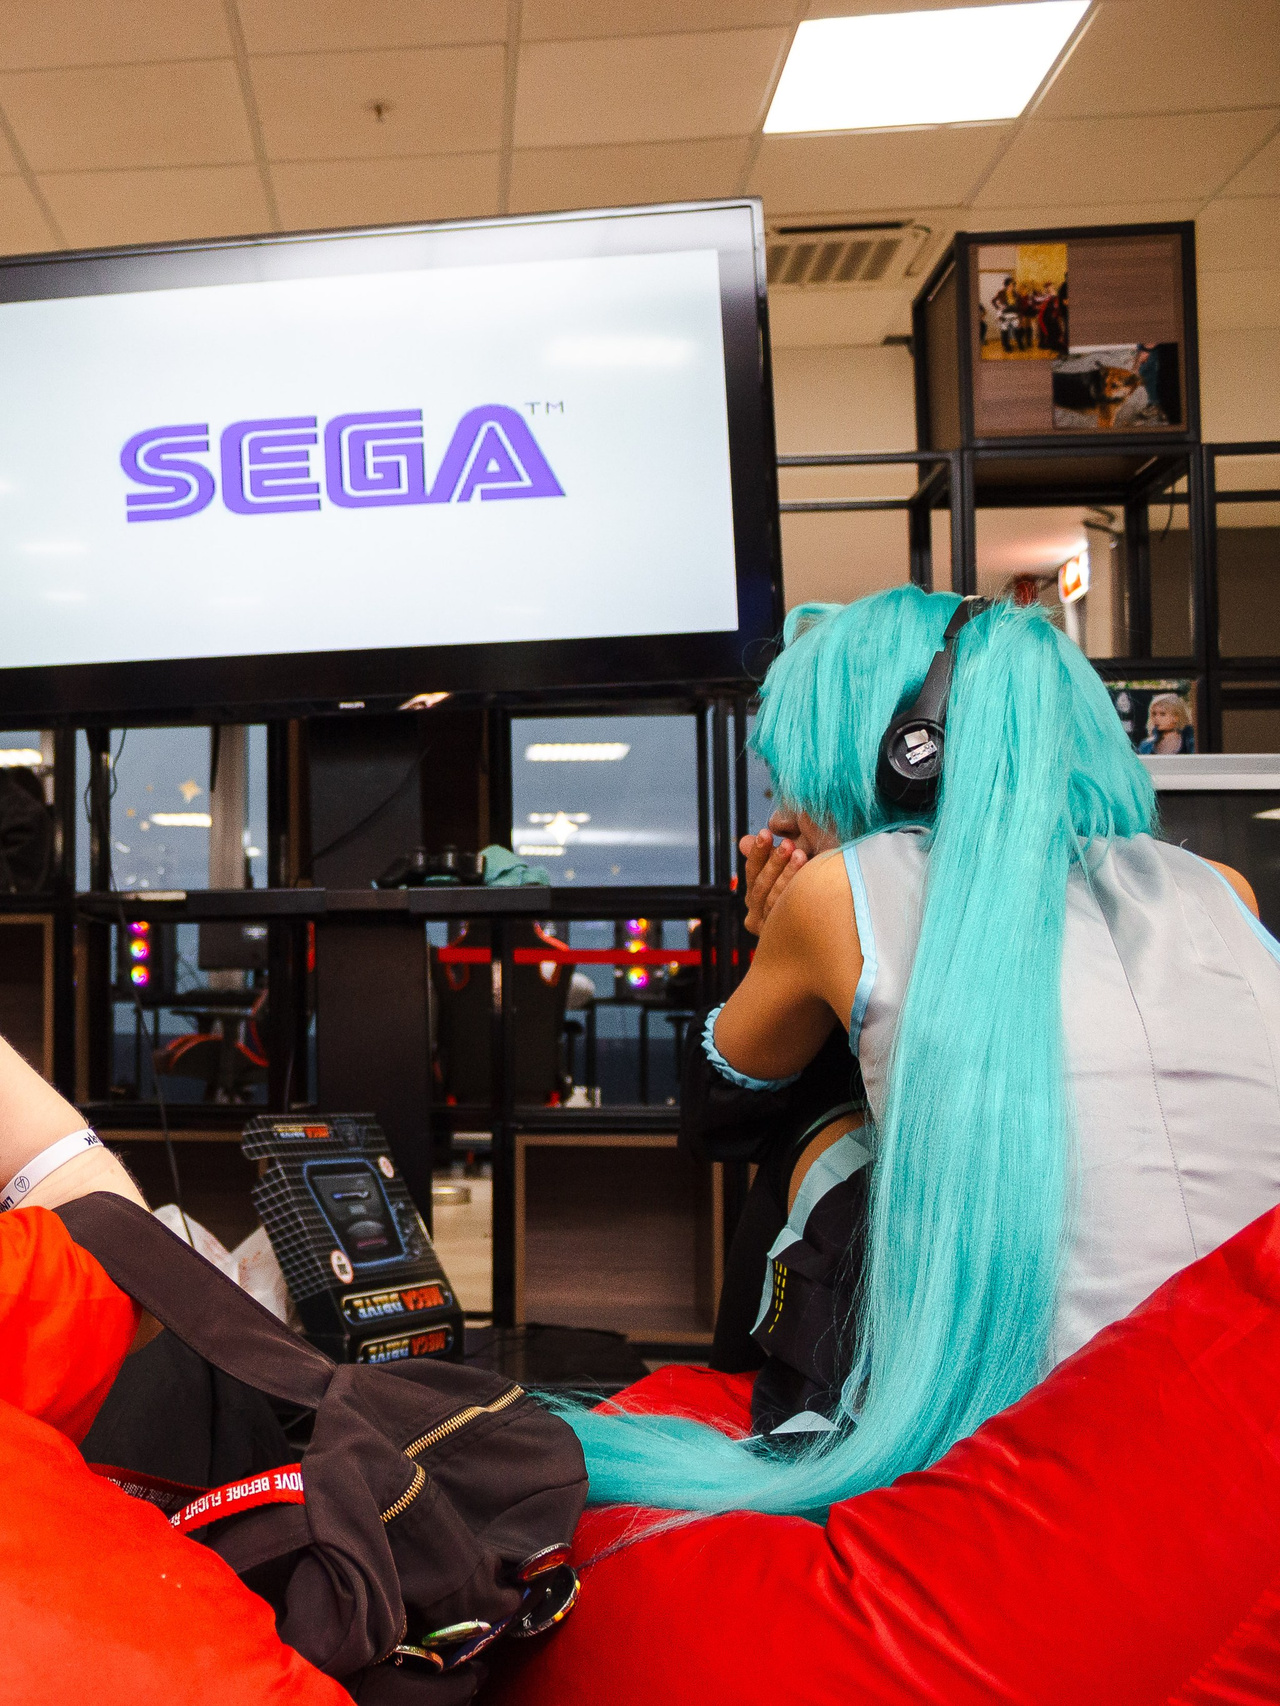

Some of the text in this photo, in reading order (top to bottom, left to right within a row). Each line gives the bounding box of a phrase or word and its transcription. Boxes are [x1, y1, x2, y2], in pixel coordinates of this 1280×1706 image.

[524, 400, 565, 416] TM
[120, 403, 566, 523] SEGA
[226, 1476, 271, 1502] BEFORE
[184, 1490, 222, 1521] FLIGHT
